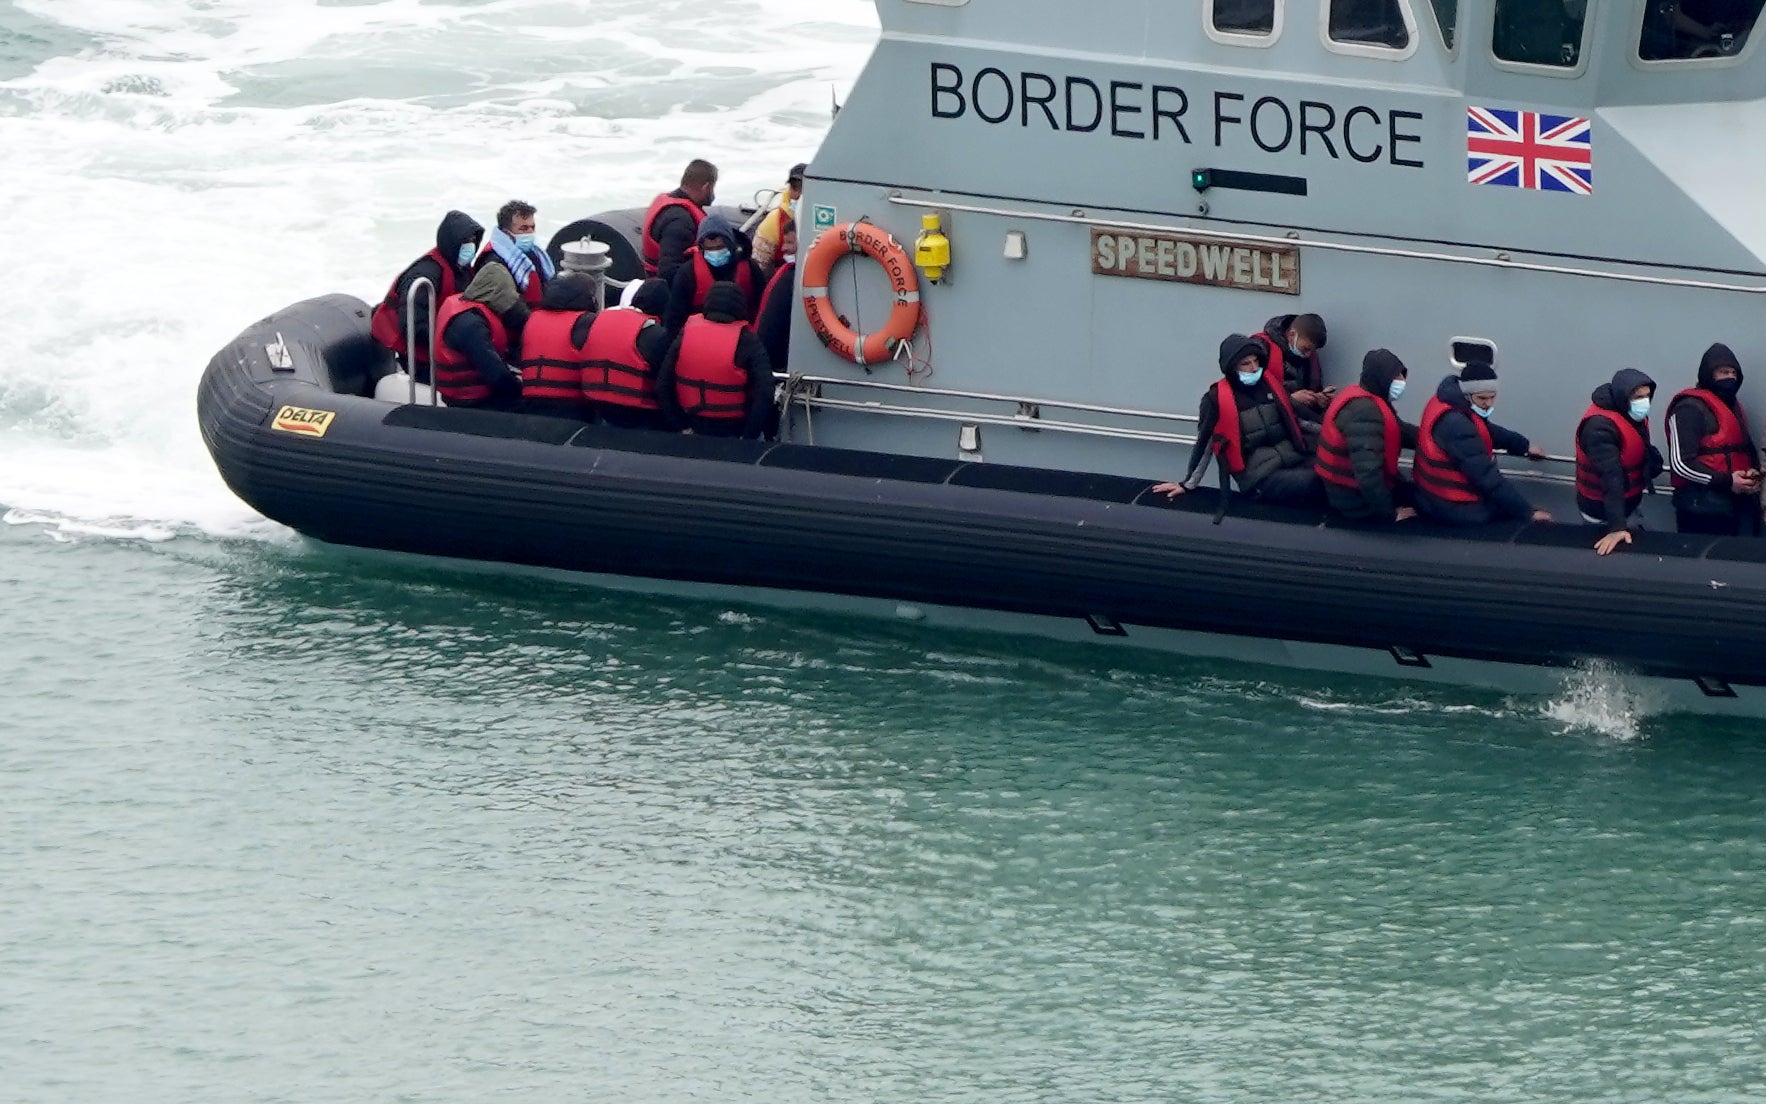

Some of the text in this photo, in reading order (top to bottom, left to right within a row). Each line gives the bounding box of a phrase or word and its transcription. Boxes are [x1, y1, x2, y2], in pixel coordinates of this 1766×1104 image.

[930, 62, 1425, 168] BORDER FORCE
[839, 230, 908, 308] BORDER FORCE
[1097, 235, 1289, 288] SPEEDWELL
[280, 408, 328, 425] DELTA
